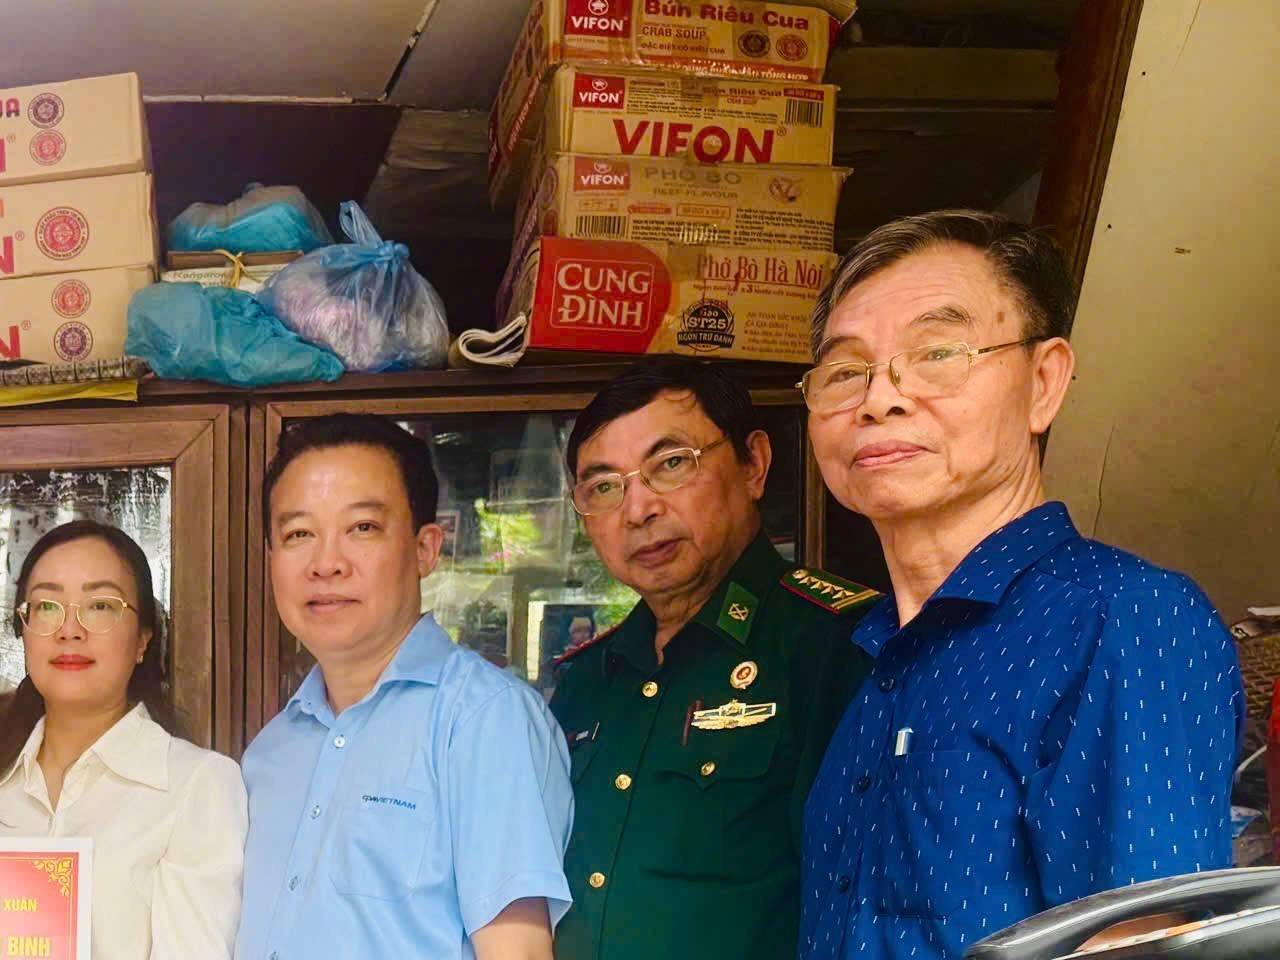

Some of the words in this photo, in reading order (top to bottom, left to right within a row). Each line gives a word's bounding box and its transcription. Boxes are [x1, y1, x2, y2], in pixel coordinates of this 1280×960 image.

[571, 15, 624, 31] VIFON
[763, 11, 809, 30] Cua
[641, 25, 672, 37] CRAB
[675, 27, 707, 39] SOUP
[579, 92, 620, 103] VIFON
[613, 118, 775, 163] VIFON
[581, 174, 625, 186] VIFON
[557, 263, 651, 294] CUNG
[765, 257, 789, 283] Hà
[795, 259, 825, 287] Nội
[557, 293, 645, 327] ĐÌNH
[687, 318, 727, 330] ST25
[4, 896, 38, 912] XUÂN
[8, 936, 52, 957] BINH
